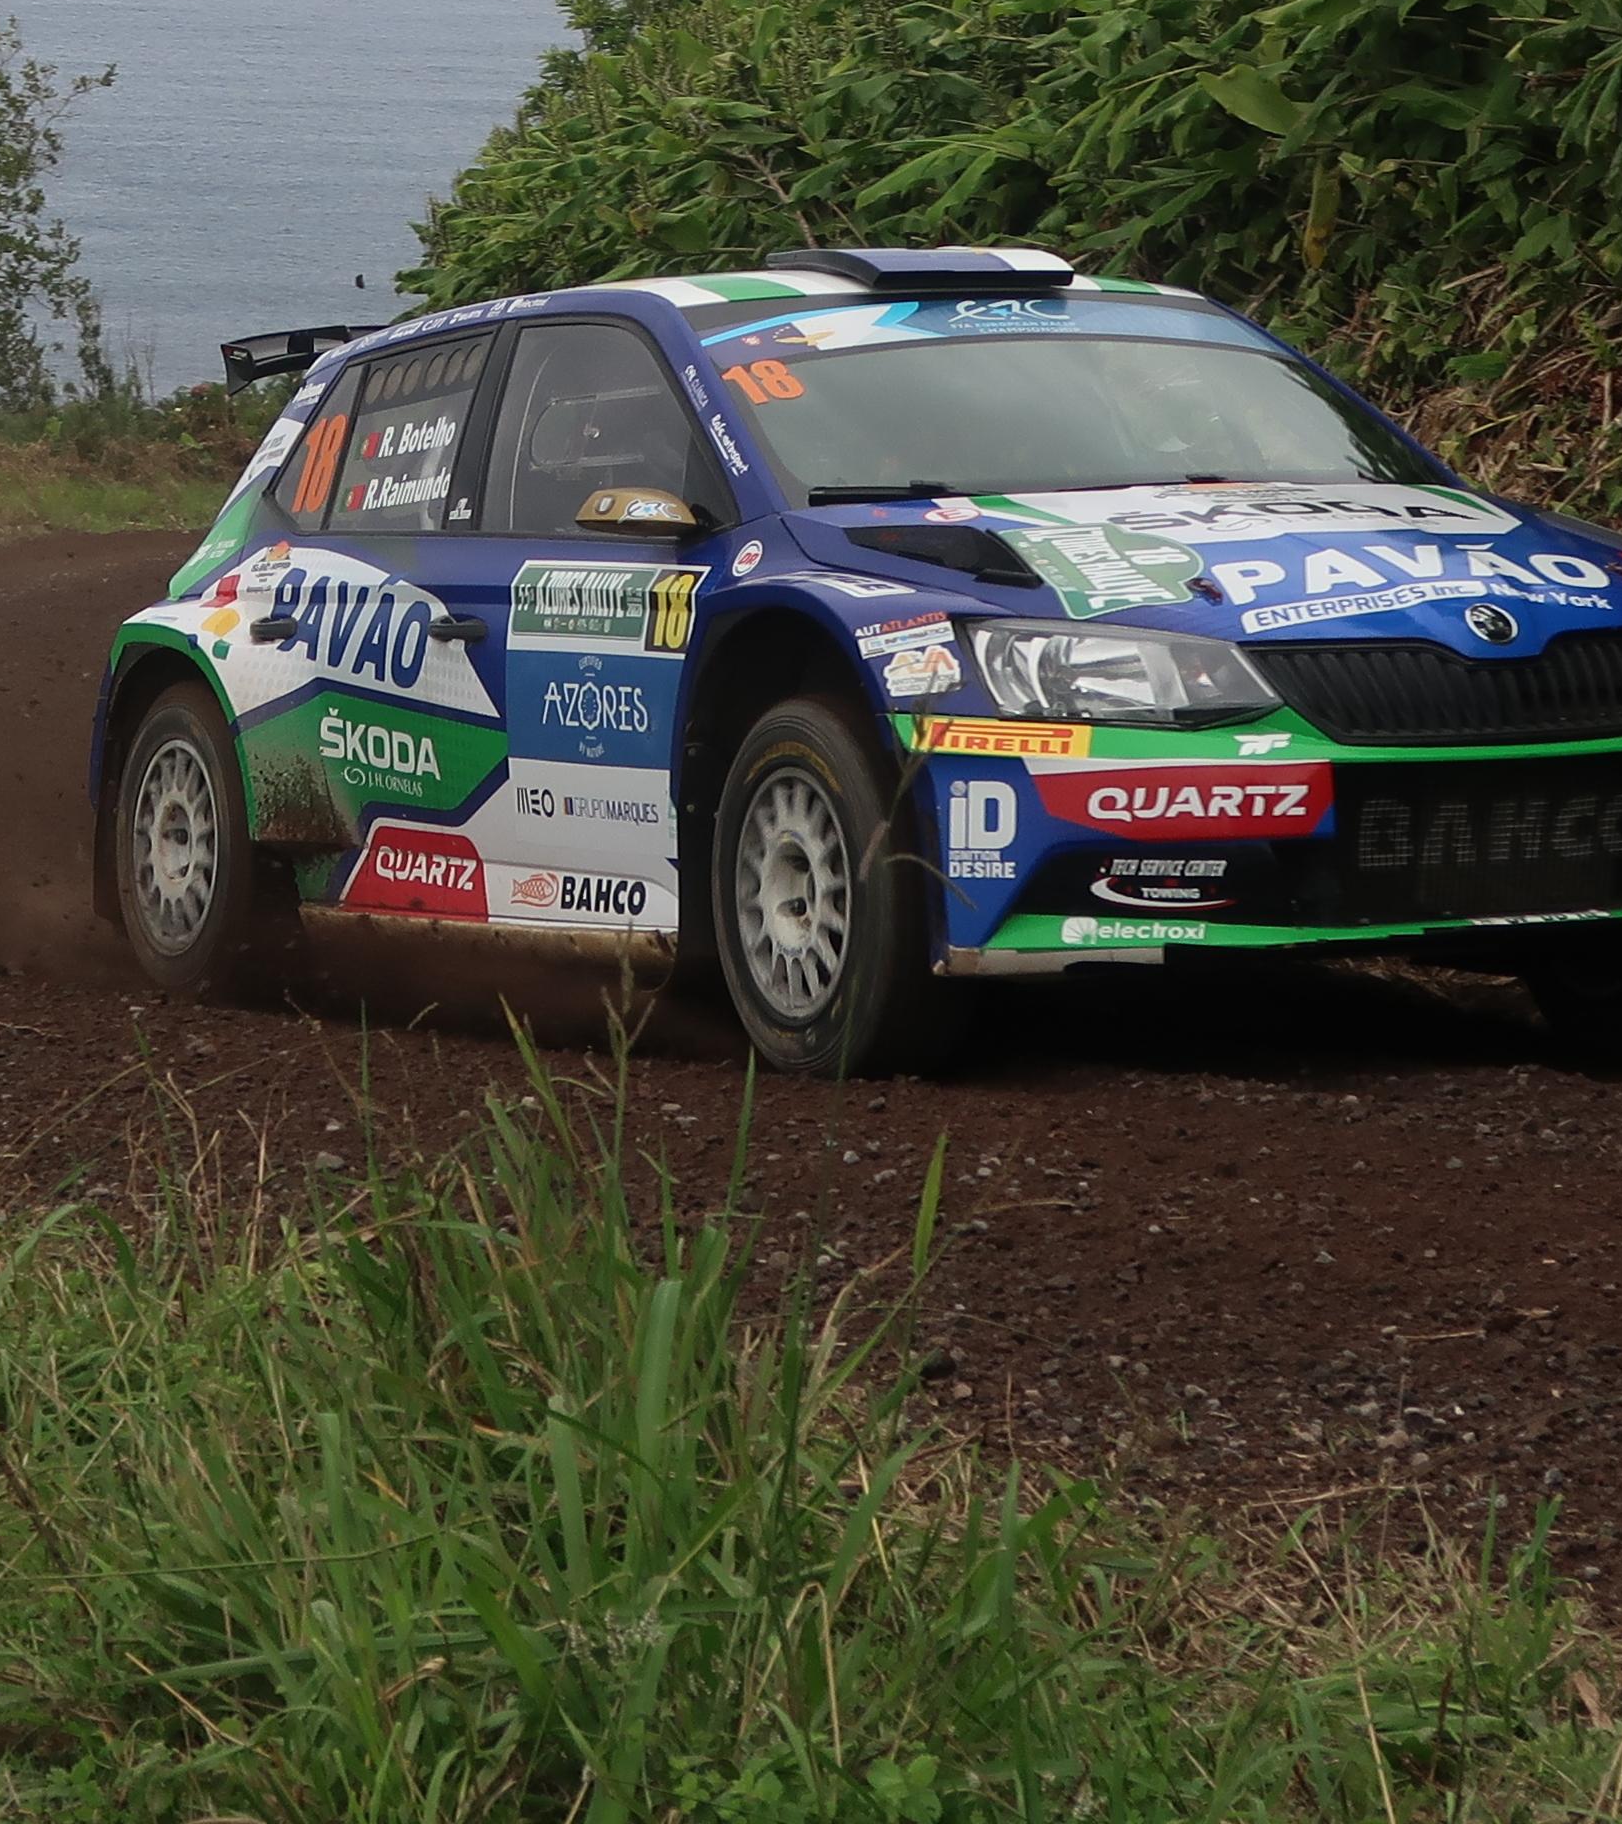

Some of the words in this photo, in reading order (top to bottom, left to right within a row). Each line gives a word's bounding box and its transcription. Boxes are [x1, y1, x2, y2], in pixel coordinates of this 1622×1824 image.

[721, 360, 805, 405] 18
[378, 426, 395, 458] R.
[397, 415, 457, 456] Botelho
[291, 414, 348, 513] 18
[1125, 545, 1191, 566] 18
[1210, 543, 1611, 606] PAVÃO
[652, 573, 696, 649] 18
[1255, 586, 1427, 627] ENTERPRISES
[1551, 589, 1613, 610] York
[542, 681, 648, 732] AZORES
[319, 707, 441, 781] ŠKODA
[930, 722, 1075, 754] PIRELLI
[516, 787, 555, 818] MEO
[1087, 784, 1310, 823] QUARTZ
[376, 845, 478, 891] QUARTZ
[948, 862, 1017, 879] DESIRE
[559, 875, 647, 916] BAHCO
[1140, 887, 1202, 900] TOWING
[1097, 922, 1206, 940] electroxi
